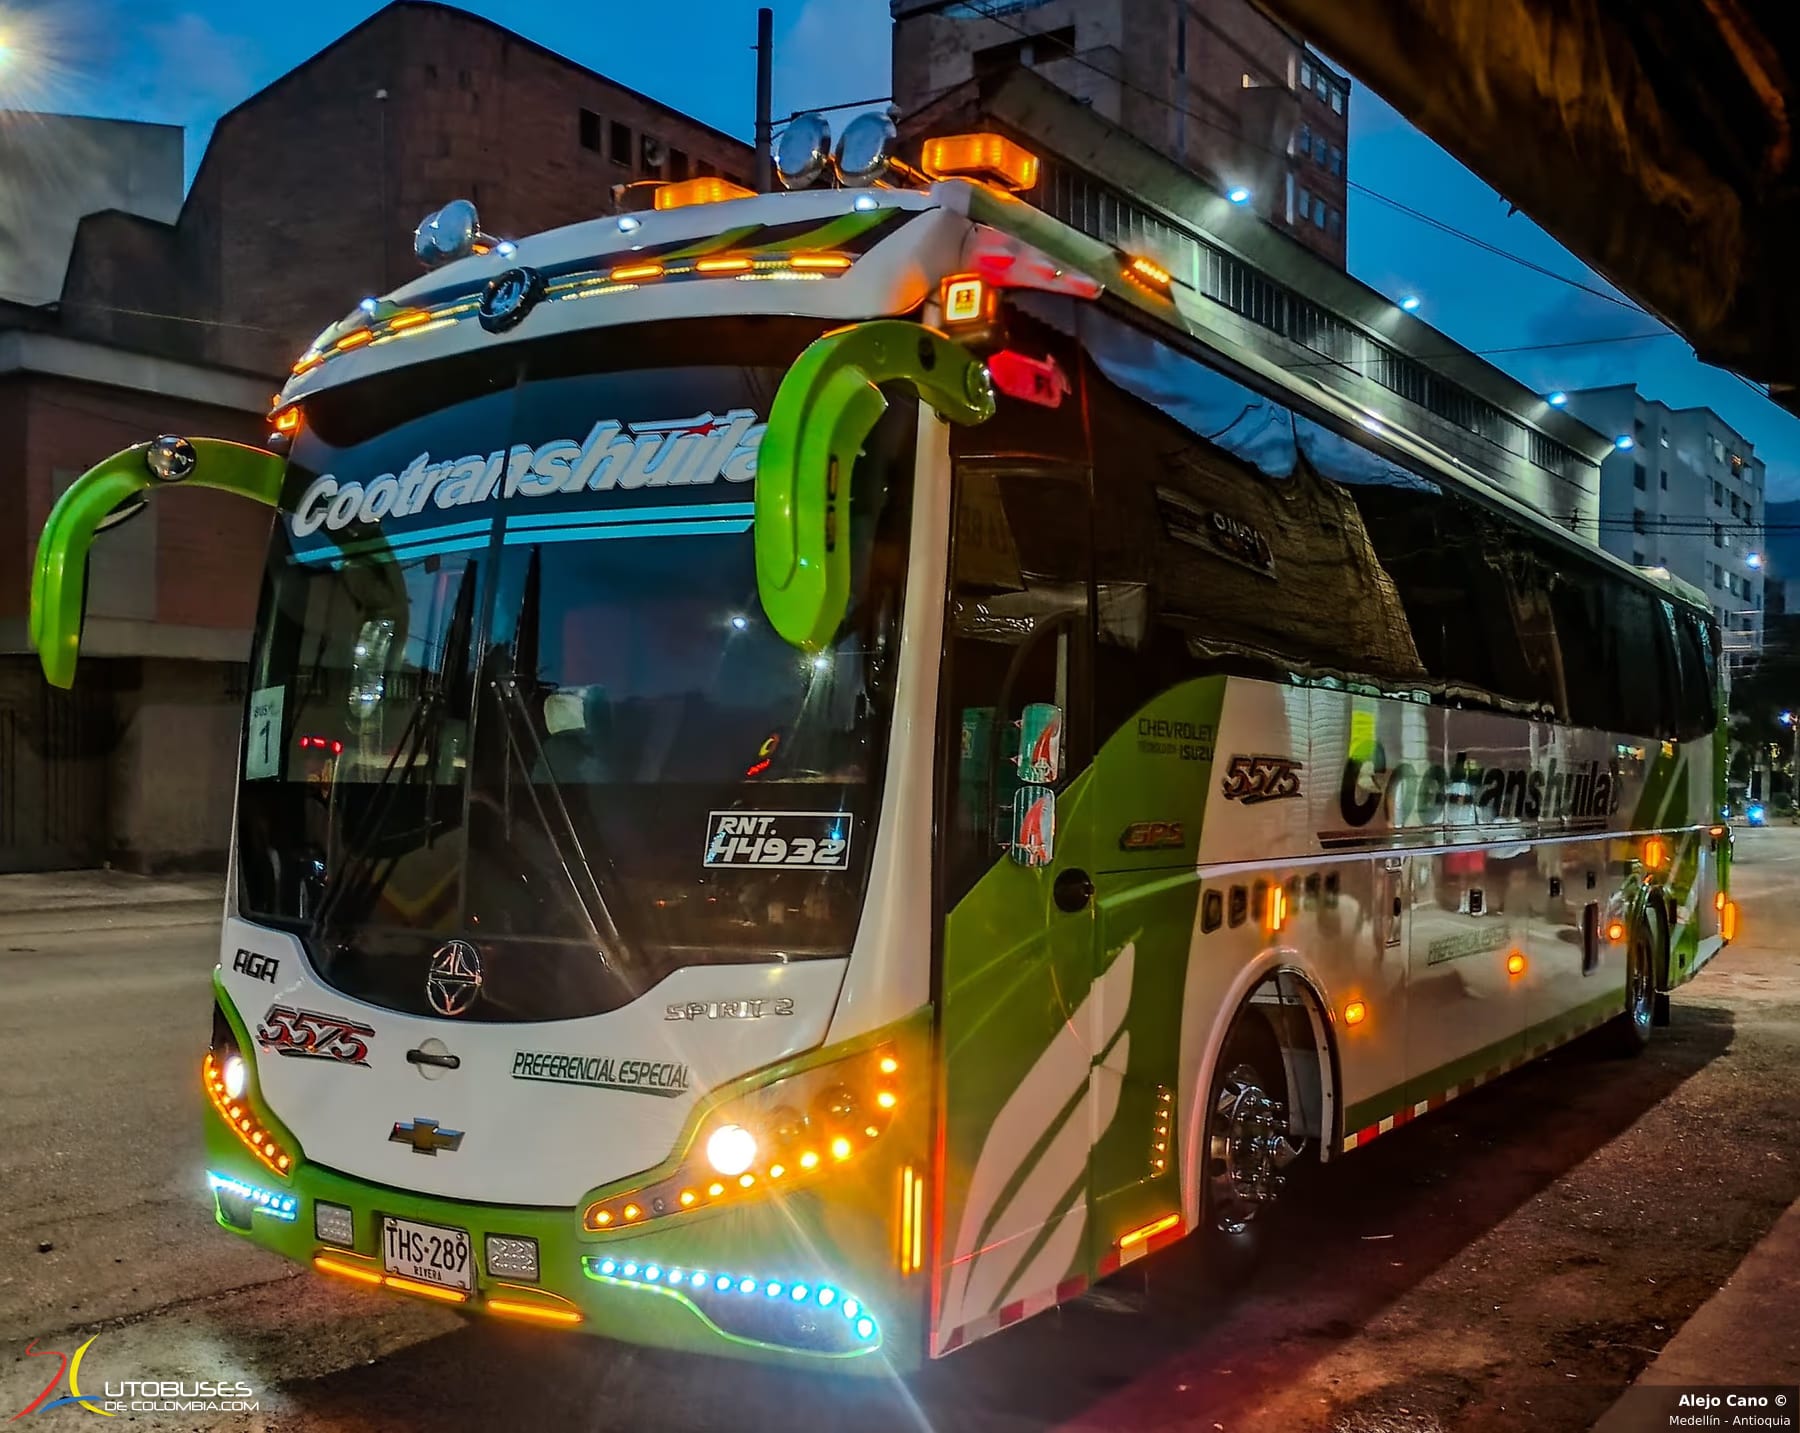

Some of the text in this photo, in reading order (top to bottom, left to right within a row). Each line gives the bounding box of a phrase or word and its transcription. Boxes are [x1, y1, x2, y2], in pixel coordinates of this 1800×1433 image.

[1137, 718, 1215, 741] CHEVROLET
[717, 816, 776, 836] RNT.
[712, 832, 845, 864] 44932
[233, 949, 280, 984] AGA
[664, 1000, 763, 1020] SPIRIT
[256, 1004, 375, 1067] 5575
[512, 1052, 688, 1088] PREFERENCIAL ESPECIAL
[413, 1265, 442, 1281] RIVERA
